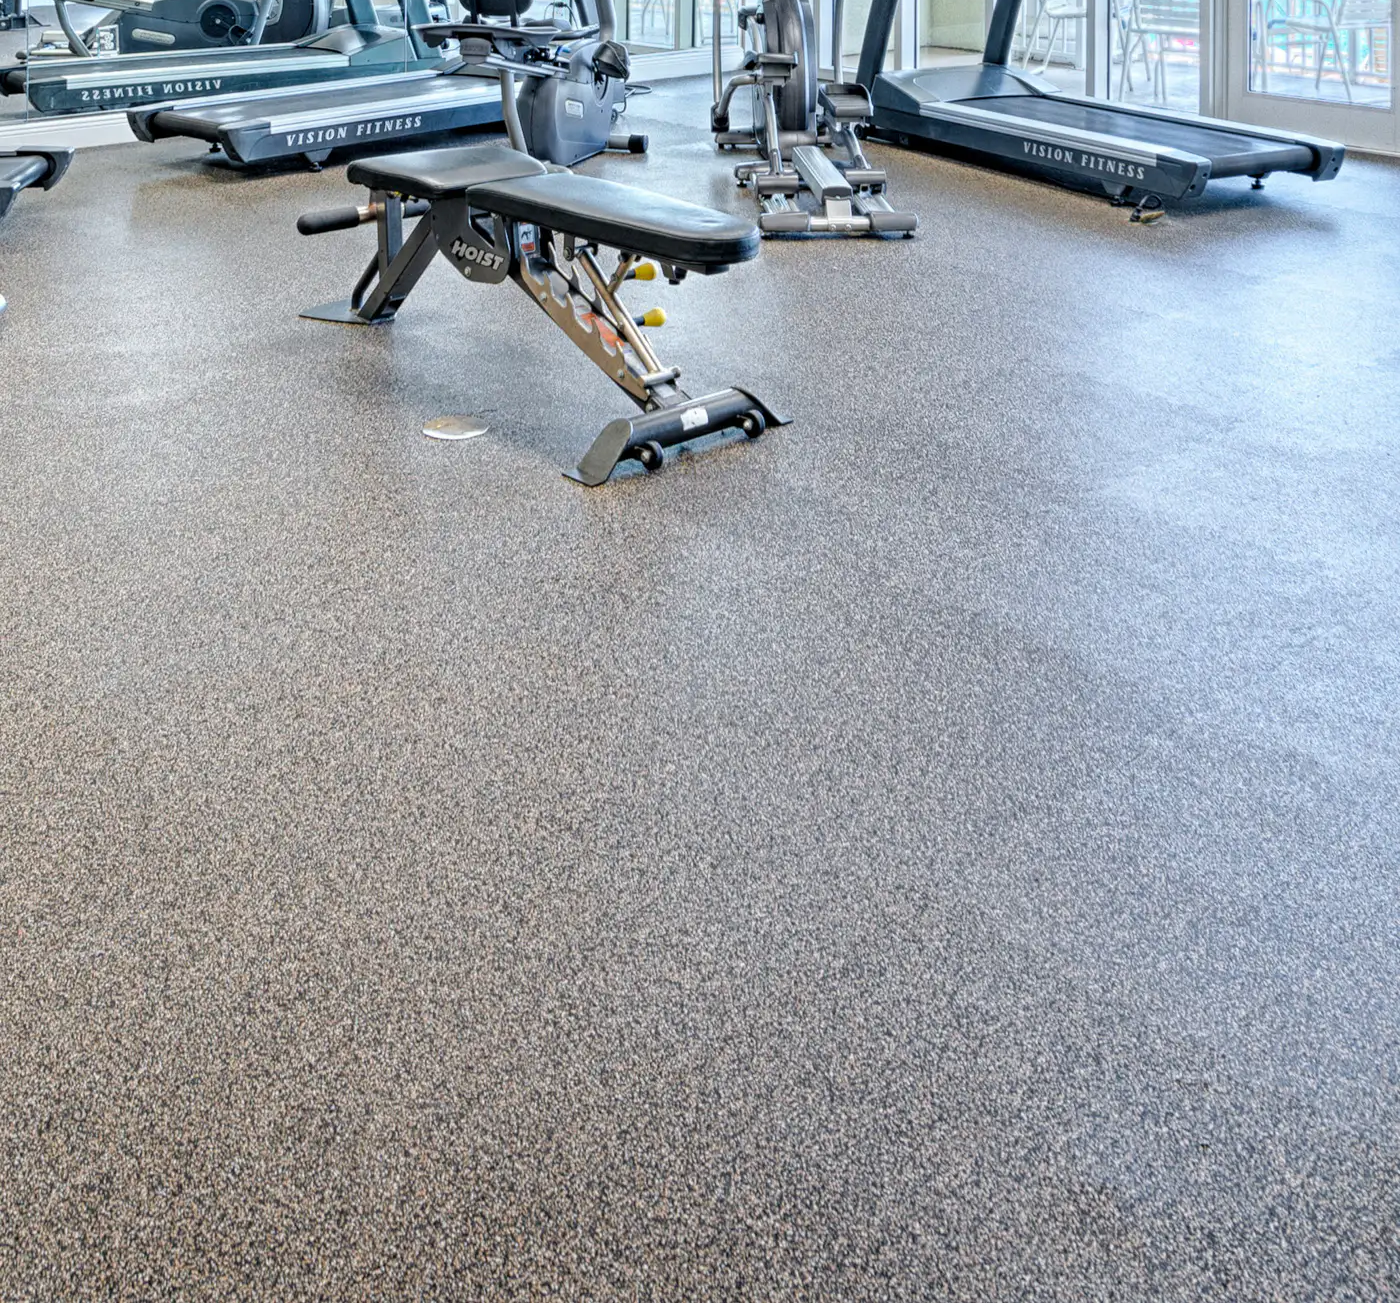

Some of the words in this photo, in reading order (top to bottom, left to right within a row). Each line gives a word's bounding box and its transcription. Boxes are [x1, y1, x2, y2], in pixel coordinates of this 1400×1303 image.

[286, 126, 348, 147] VISION
[355, 115, 422, 136] FITNESS
[1023, 141, 1074, 164] VISION
[1081, 154, 1145, 180] FITNESS
[451, 240, 504, 270] HOIST
